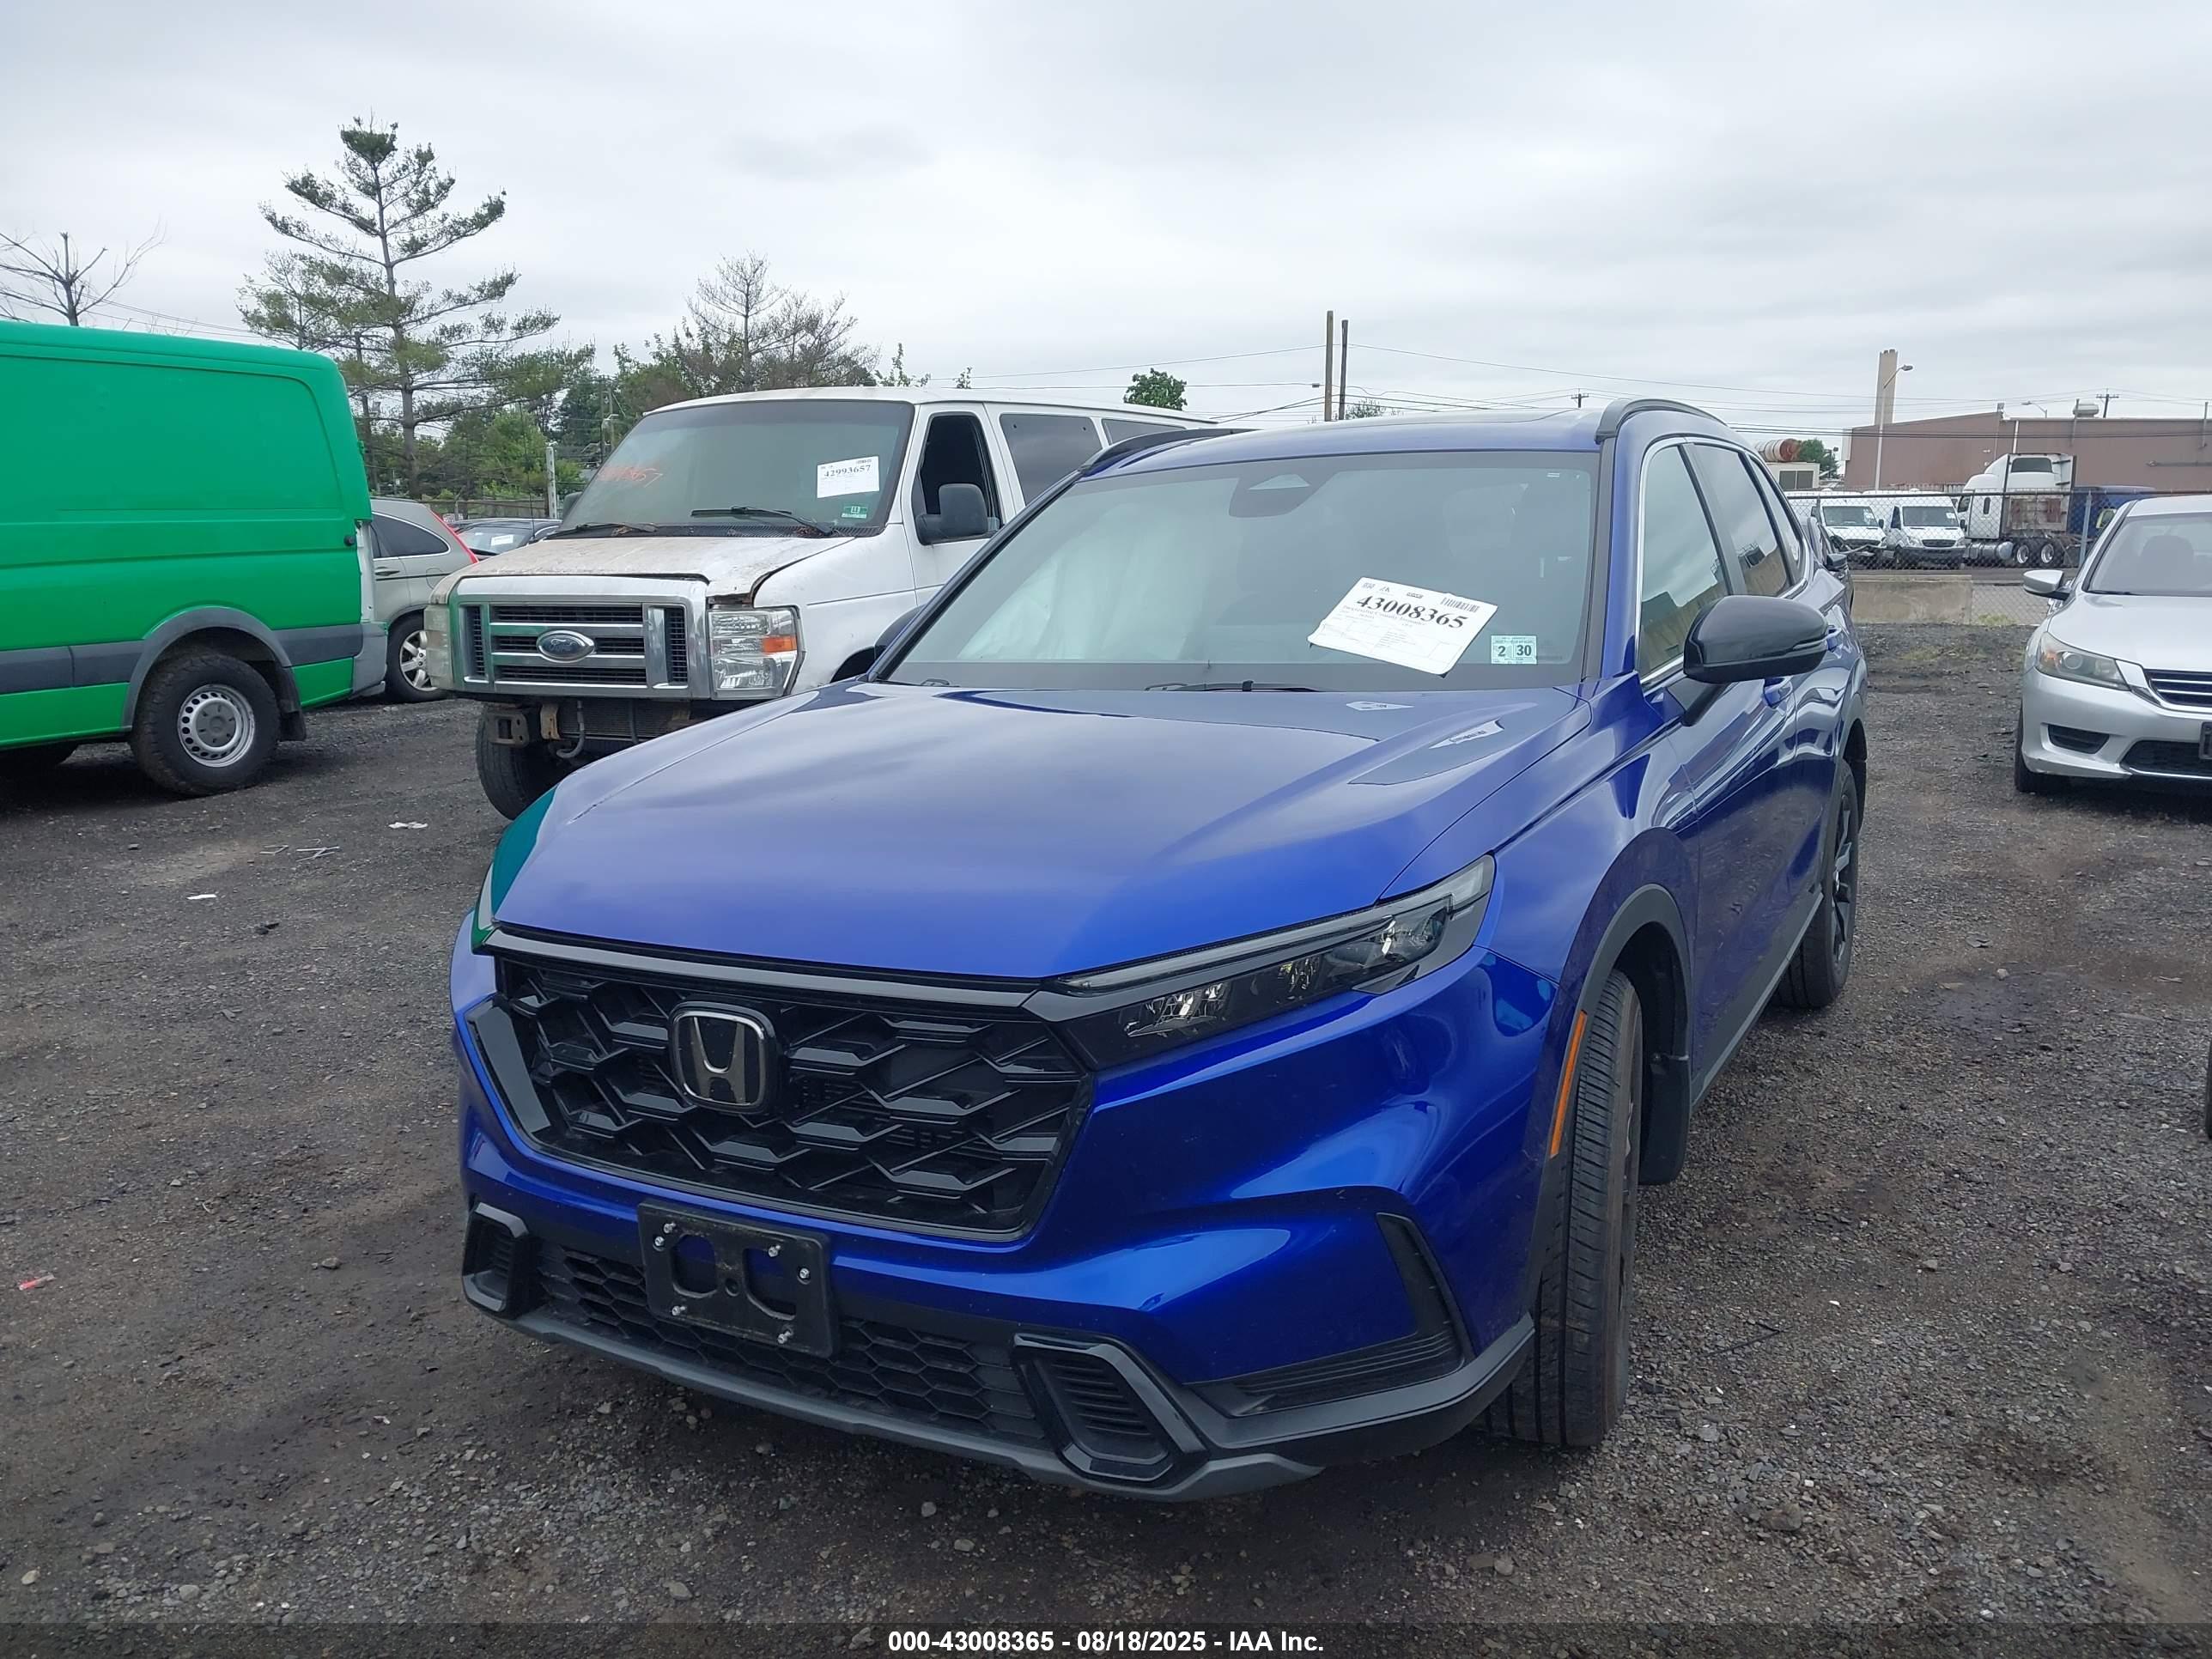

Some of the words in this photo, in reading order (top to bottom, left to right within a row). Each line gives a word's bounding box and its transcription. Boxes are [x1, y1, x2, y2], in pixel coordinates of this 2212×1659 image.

[824, 465, 871, 477] 42993657
[1356, 595, 1469, 629] 43008365
[1498, 645, 1506, 657] 2
[1516, 644, 1532, 657] 30
